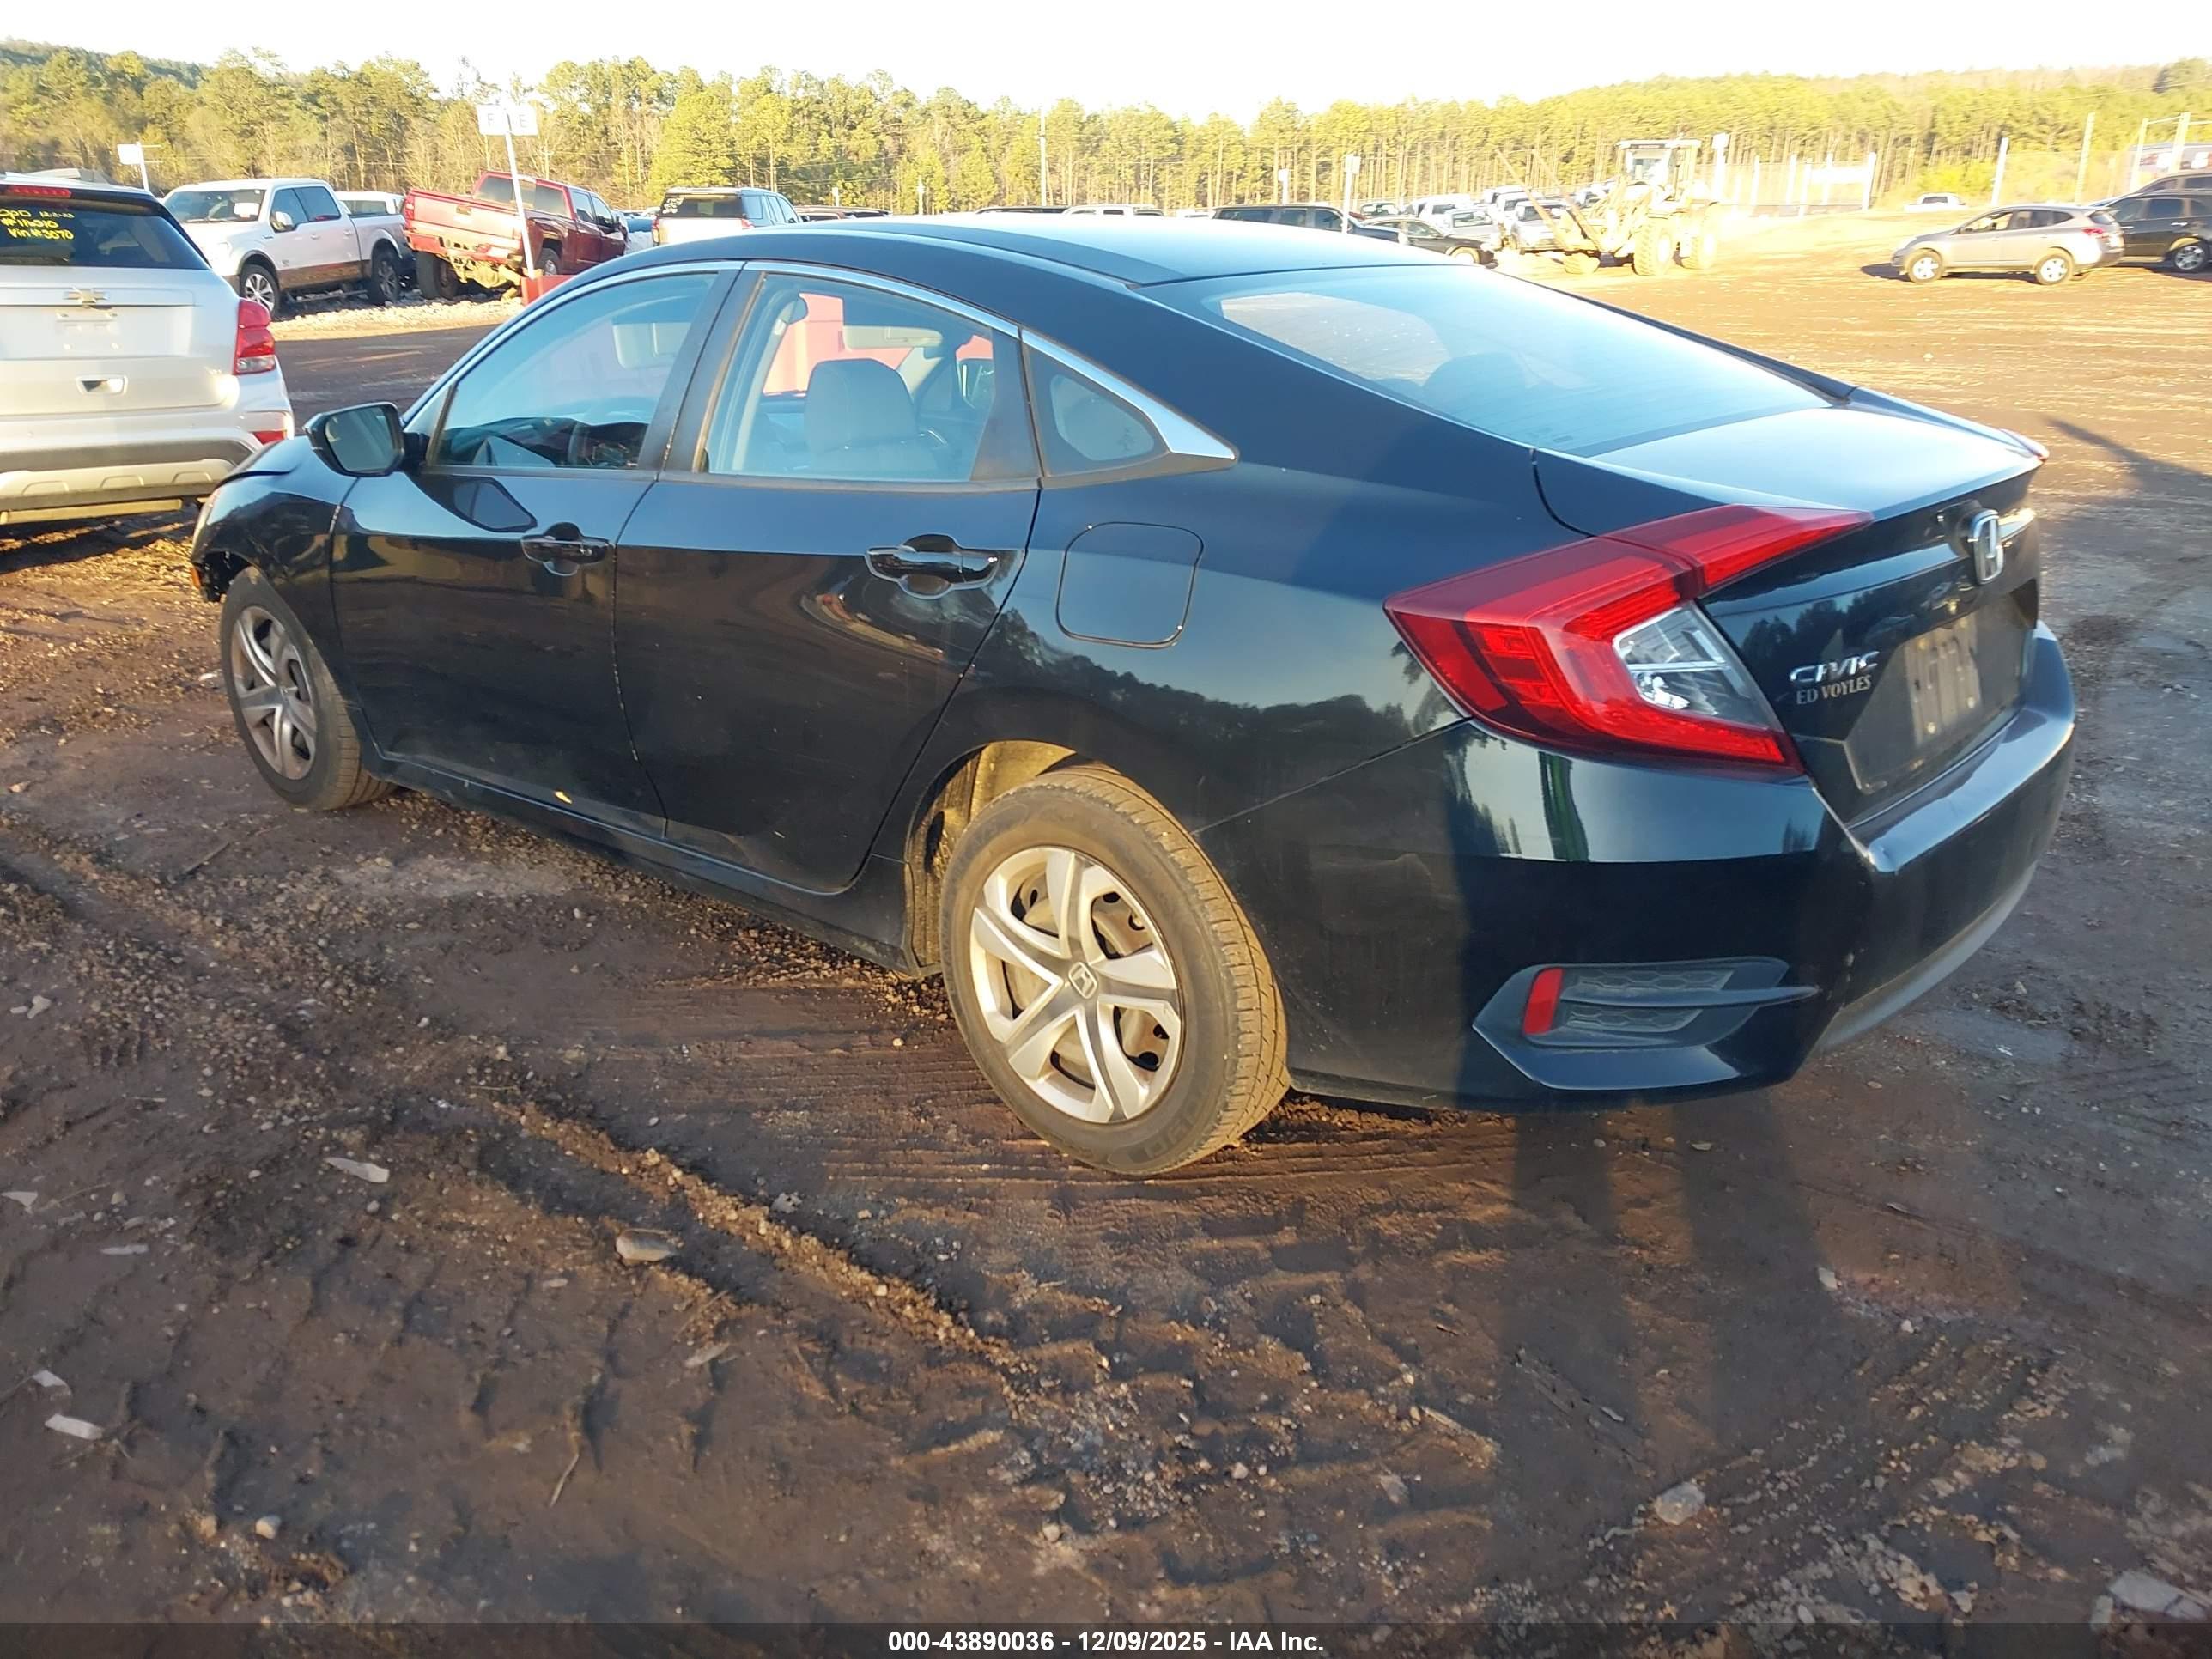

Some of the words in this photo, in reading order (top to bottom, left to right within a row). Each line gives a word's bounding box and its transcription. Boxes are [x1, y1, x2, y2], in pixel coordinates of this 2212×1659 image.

[519, 114, 529, 128] E
[1796, 688, 1819, 704] ED
[1821, 674, 1871, 698] VOYLES
